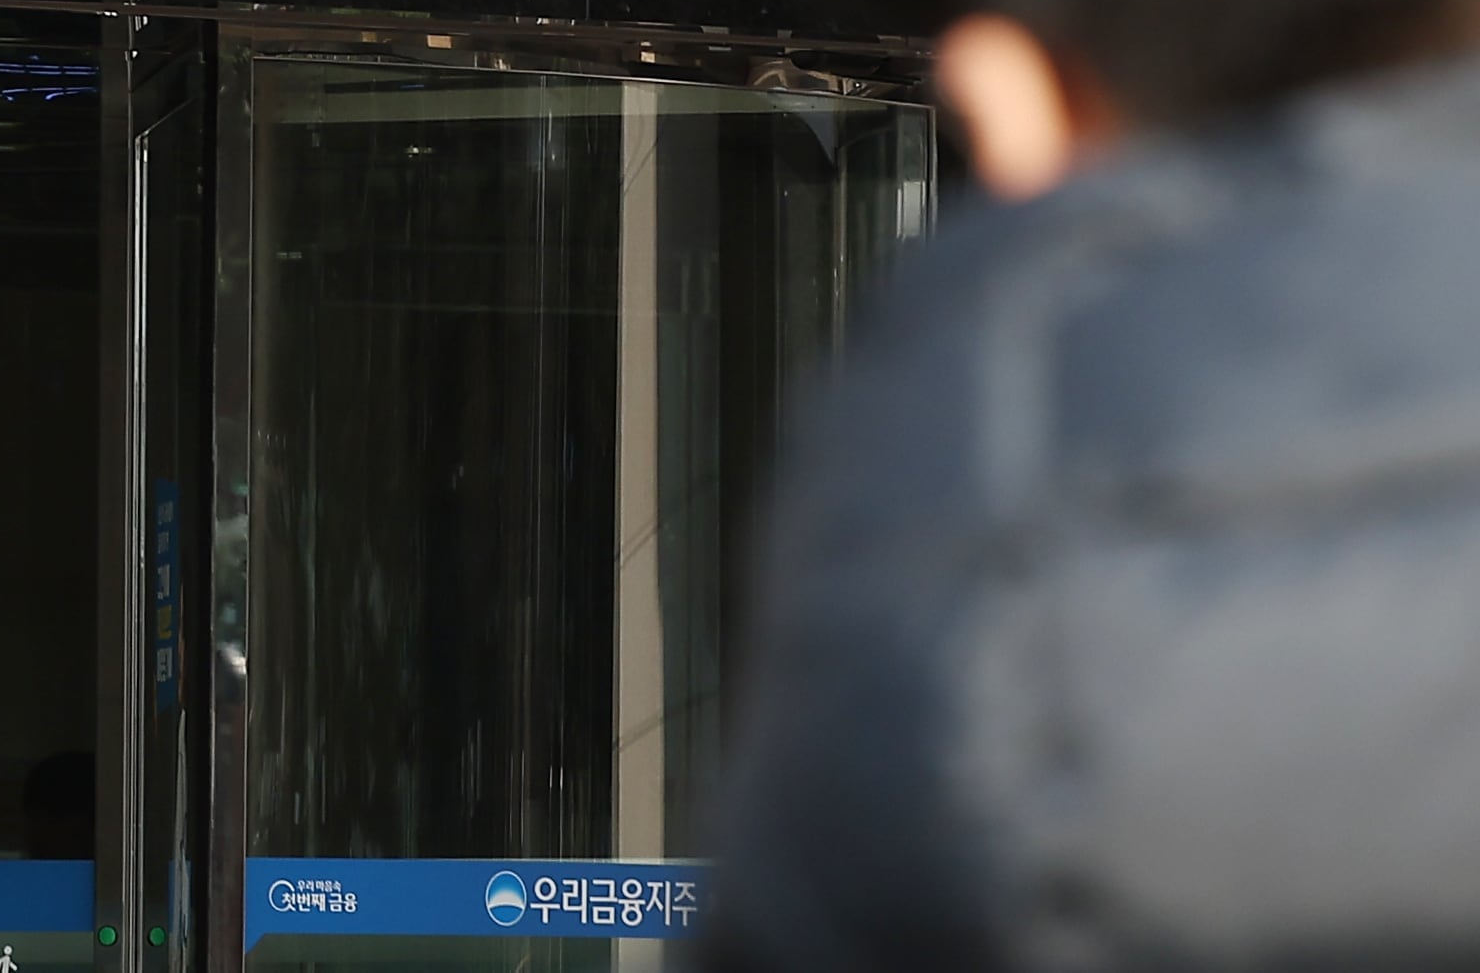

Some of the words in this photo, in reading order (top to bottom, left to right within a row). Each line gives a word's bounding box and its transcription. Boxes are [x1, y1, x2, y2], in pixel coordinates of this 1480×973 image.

[281, 892, 326, 912] 첫번째
[328, 892, 358, 913] 금융
[529, 876, 698, 927] 우리금융지주
